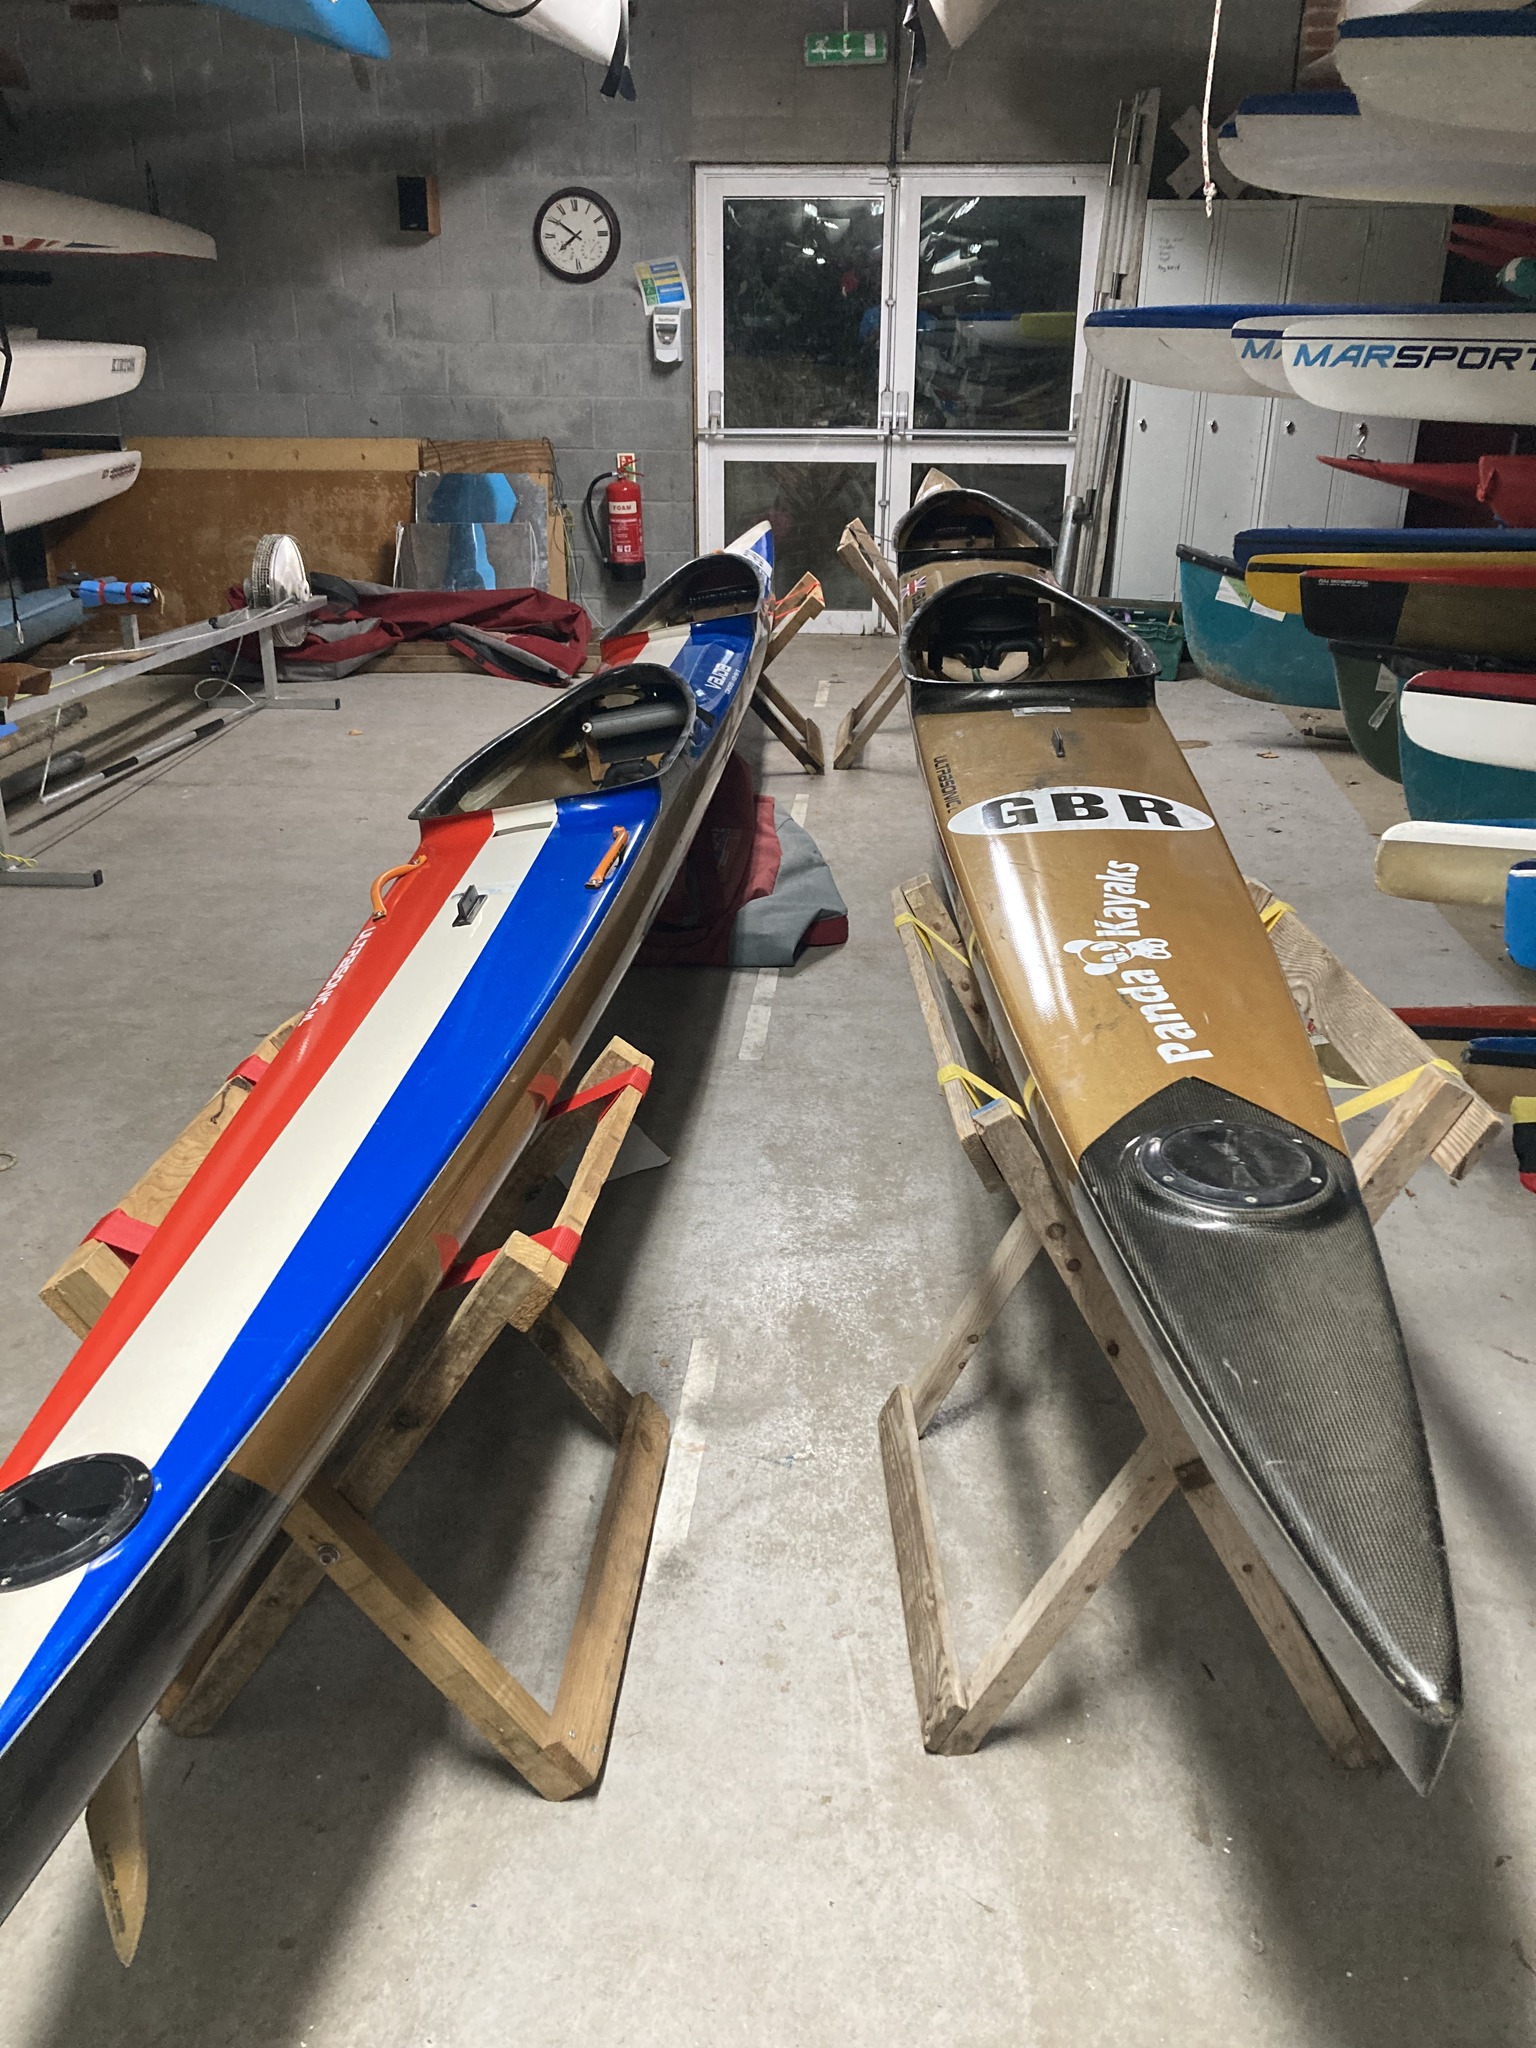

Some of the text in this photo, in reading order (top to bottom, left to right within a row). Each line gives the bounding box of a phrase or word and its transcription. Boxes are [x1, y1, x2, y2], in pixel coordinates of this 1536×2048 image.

[981, 792, 1185, 830] GBR
[1094, 860, 1213, 1064] Panda Kayaks
